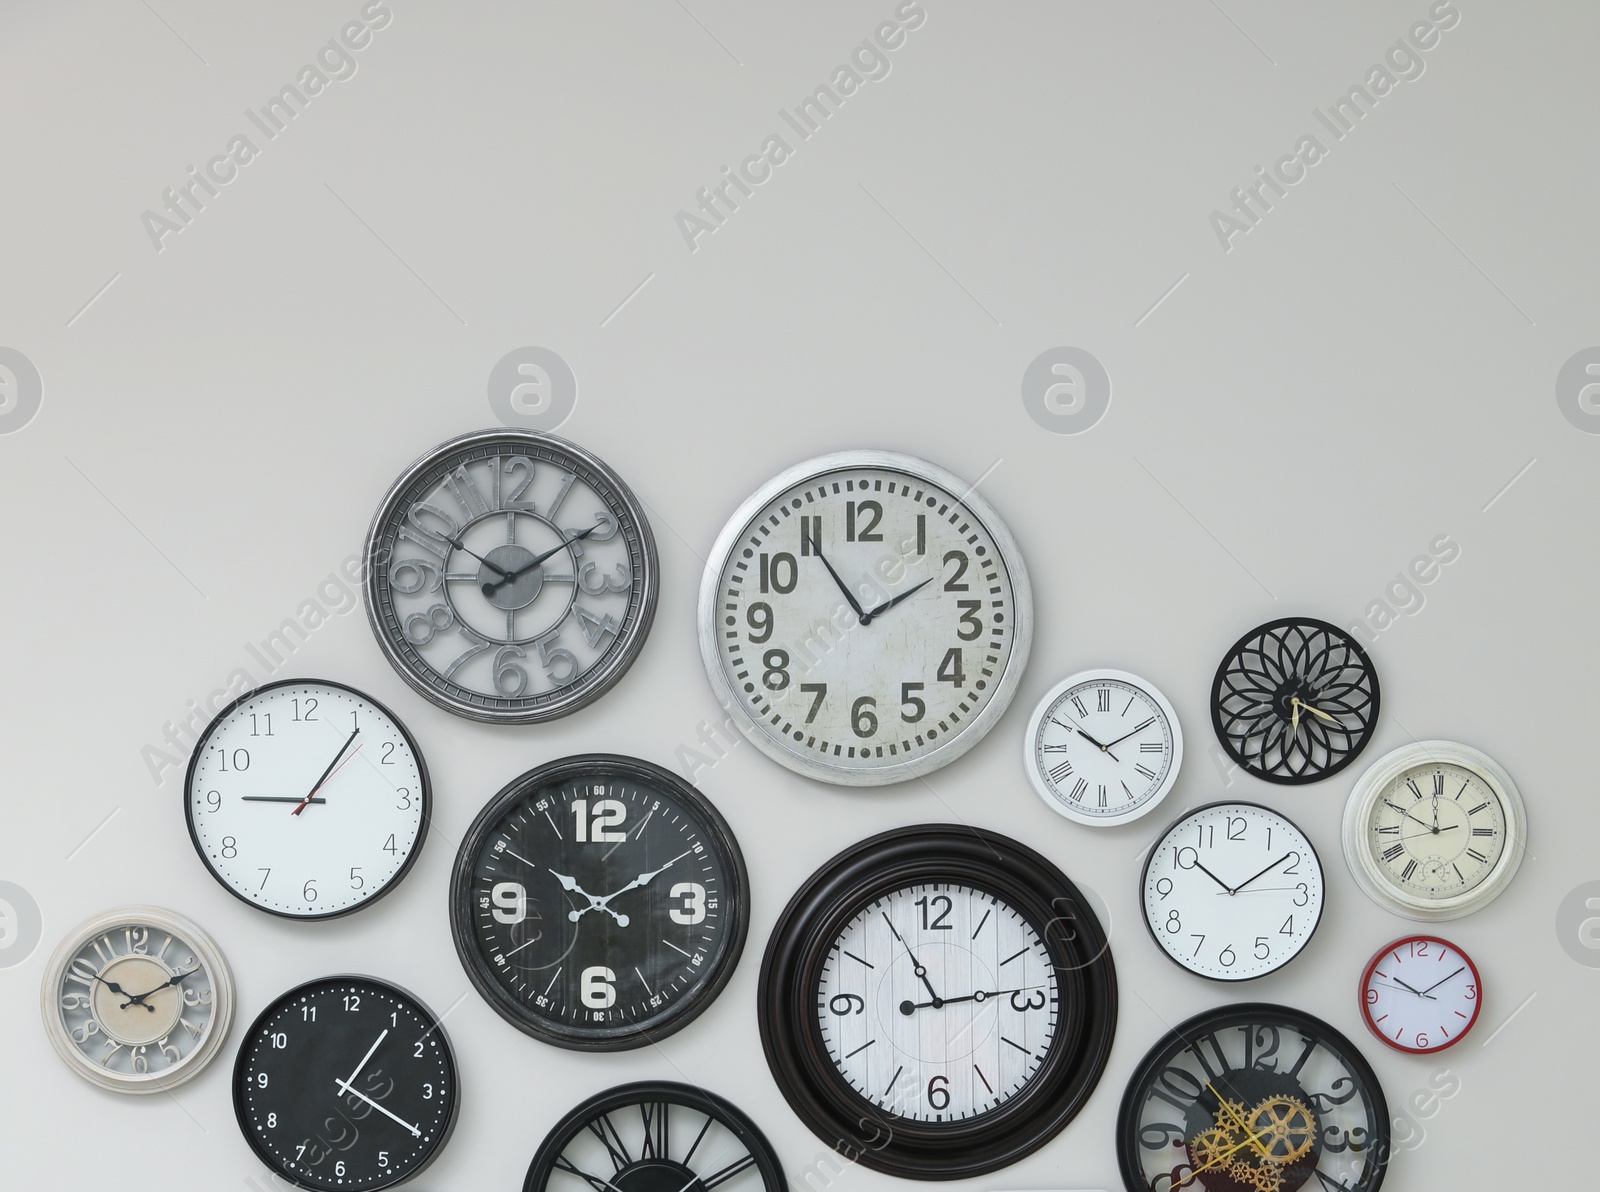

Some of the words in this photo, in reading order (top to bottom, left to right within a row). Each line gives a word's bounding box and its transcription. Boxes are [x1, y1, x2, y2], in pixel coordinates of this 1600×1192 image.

[441, 458, 491, 523] 11
[488, 456, 535, 511] 12
[547, 473, 576, 521] 1
[399, 502, 459, 559] 10
[846, 500, 883, 542] 12
[563, 511, 619, 557] 2
[800, 515, 822, 556] 11
[916, 514, 926, 555] 1
[389, 558, 442, 593] 9
[578, 562, 631, 596] 3
[759, 552, 798, 594] 10
[943, 550, 969, 592] 2
[403, 603, 454, 646] 8
[571, 602, 620, 648] 4
[746, 601, 774, 644] 9
[956, 600, 983, 641] 3
[442, 626, 491, 679] 7
[535, 629, 578, 686] 5
[492, 645, 527, 698] 6
[762, 649, 790, 690] 8
[936, 647, 966, 688] 4
[291, 698, 319, 721] 12
[800, 683, 827, 723] 7
[900, 682, 926, 723] 5
[250, 713, 275, 736] 11
[350, 711, 361, 733] 1
[851, 696, 878, 738] 6
[218, 748, 250, 772] 10
[381, 742, 395, 764] 2
[206, 790, 221, 813] 9
[396, 787, 411, 810] 3
[593, 785, 605, 796] 60
[536, 800, 549, 813] 55
[651, 801, 661, 811] 5
[571, 799, 627, 843] 12
[1226, 816, 1247, 841] 12
[221, 836, 237, 859] 8
[382, 833, 398, 856] 4
[494, 840, 507, 853] 50
[691, 840, 704, 854] 10
[1198, 825, 1213, 848] 11
[1267, 828, 1271, 851] 1
[1173, 846, 1198, 870] 10
[1282, 851, 1300, 875] 2
[258, 868, 271, 891] 7
[303, 879, 318, 902] 6
[350, 867, 364, 890] 5
[1156, 878, 1173, 900] 9
[480, 896, 490, 908] 45
[491, 882, 527, 925] 9
[669, 882, 706, 925] 3
[707, 897, 718, 909] 15
[1293, 883, 1308, 906] 3
[915, 895, 953, 931] 12
[1166, 910, 1181, 934] 8
[1279, 914, 1294, 937] 4
[87, 933, 120, 964] 11
[121, 926, 148, 955] 12
[152, 932, 174, 962] 1
[1190, 934, 1205, 957] 7
[1254, 937, 1270, 960] 5
[1410, 941, 1428, 958] 12
[172, 955, 202, 976] 2
[494, 954, 506, 966] 40
[691, 953, 704, 966] 20
[1219, 944, 1236, 967] 6
[65, 957, 99, 991] 10
[183, 988, 212, 1007] 3
[580, 966, 617, 1009] 6
[1366, 989, 1378, 1004] 9
[1464, 985, 1476, 1000] 3
[62, 992, 91, 1010] 9
[342, 996, 361, 1011] 12
[649, 994, 663, 1008] 25
[1010, 989, 1046, 1013] 3
[301, 1006, 316, 1022] 11
[391, 1012, 397, 1027] 1
[593, 1011, 605, 1022] 30
[71, 1019, 100, 1044] 8
[179, 1017, 205, 1040] 4
[270, 1032, 287, 1049] 10
[1416, 1033, 1429, 1048] 6
[101, 1038, 123, 1066] 7
[130, 1045, 148, 1074] 6
[158, 1036, 181, 1066] 5
[413, 1042, 424, 1058] 2
[1238, 1024, 1280, 1072] 12
[1283, 1035, 1319, 1086] 1
[257, 1072, 268, 1089] 9
[423, 1083, 433, 1099] 3
[927, 1075, 950, 1111] 6
[1148, 1066, 1203, 1120] 10
[1313, 1076, 1358, 1115] 2
[267, 1113, 277, 1128] 8
[1138, 1122, 1187, 1151] 9
[1321, 1125, 1369, 1153] 3
[296, 1145, 306, 1161] 7
[378, 1151, 389, 1167] 5
[335, 1161, 346, 1177] 6
